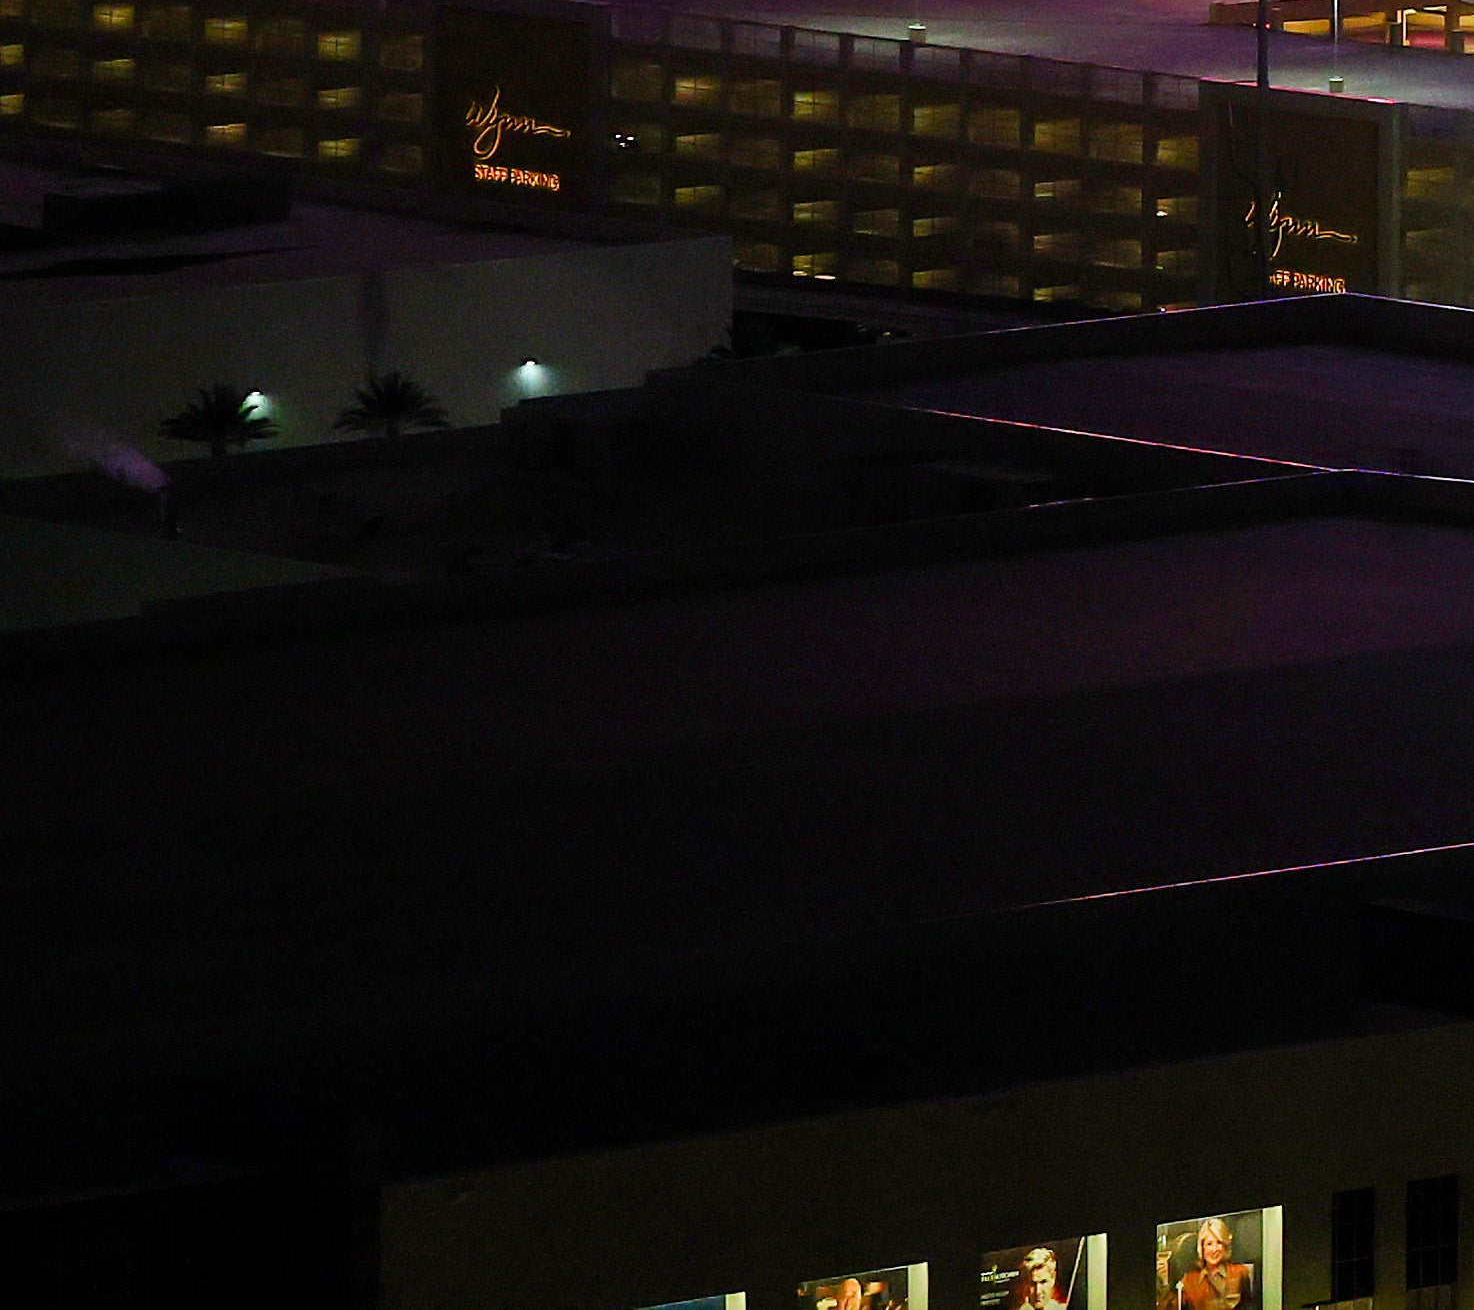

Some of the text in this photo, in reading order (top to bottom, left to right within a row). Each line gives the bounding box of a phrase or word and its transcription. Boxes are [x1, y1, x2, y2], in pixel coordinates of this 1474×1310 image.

[475, 164, 560, 191] STAFF PARKING
[1294, 272, 1346, 294] PARKING
